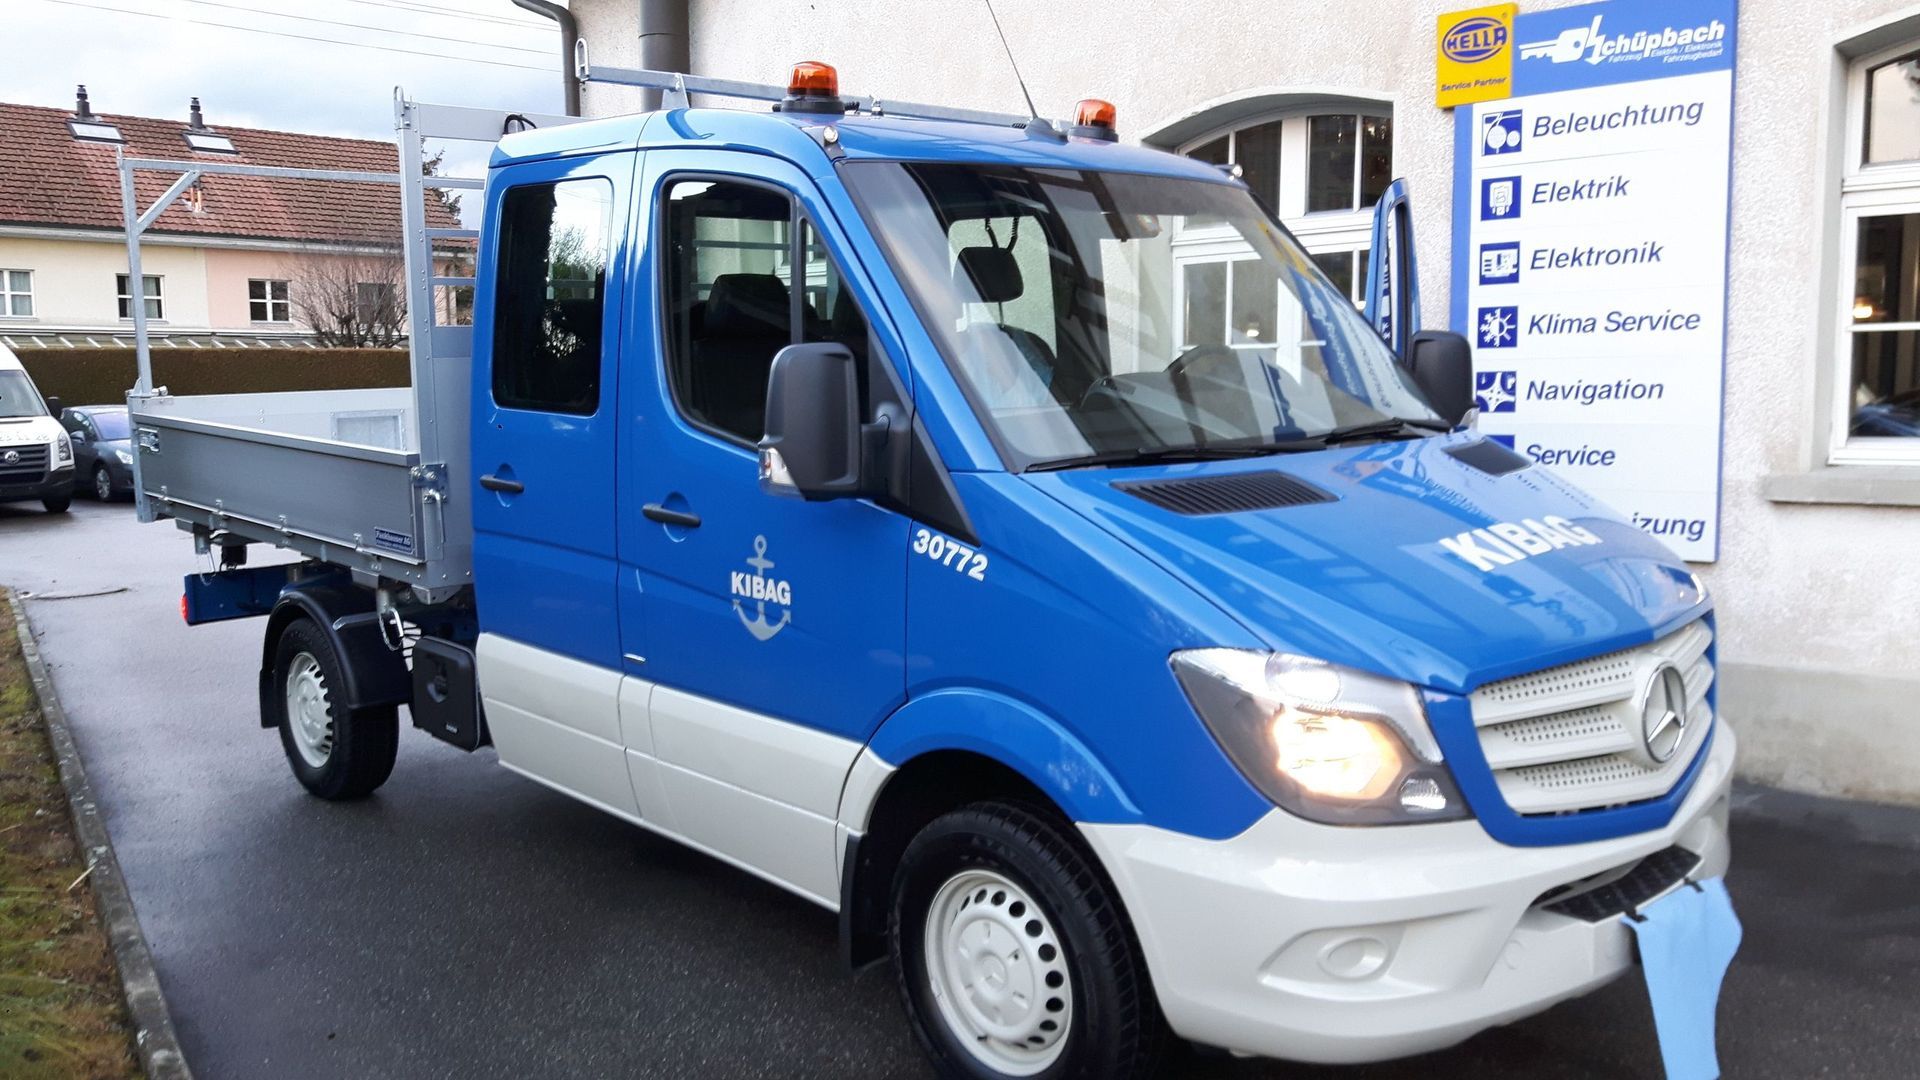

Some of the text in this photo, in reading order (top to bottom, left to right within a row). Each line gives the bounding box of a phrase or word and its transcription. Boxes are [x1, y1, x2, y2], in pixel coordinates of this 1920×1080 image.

[1447, 26, 1507, 50] HELLA
[1441, 77, 1507, 91] Service Partner
[1532, 102, 1704, 138] Beleuchtung
[1532, 175, 1631, 204] Elektrik
[1530, 241, 1664, 270] Elektronik
[1528, 309, 1701, 336] Klima Service
[1526, 379, 1664, 405] Navigation
[1526, 444, 1616, 467] Service
[912, 529, 988, 582] 30772
[1439, 515, 1604, 573] KIBAG
[731, 571, 791, 606] KIBAG
